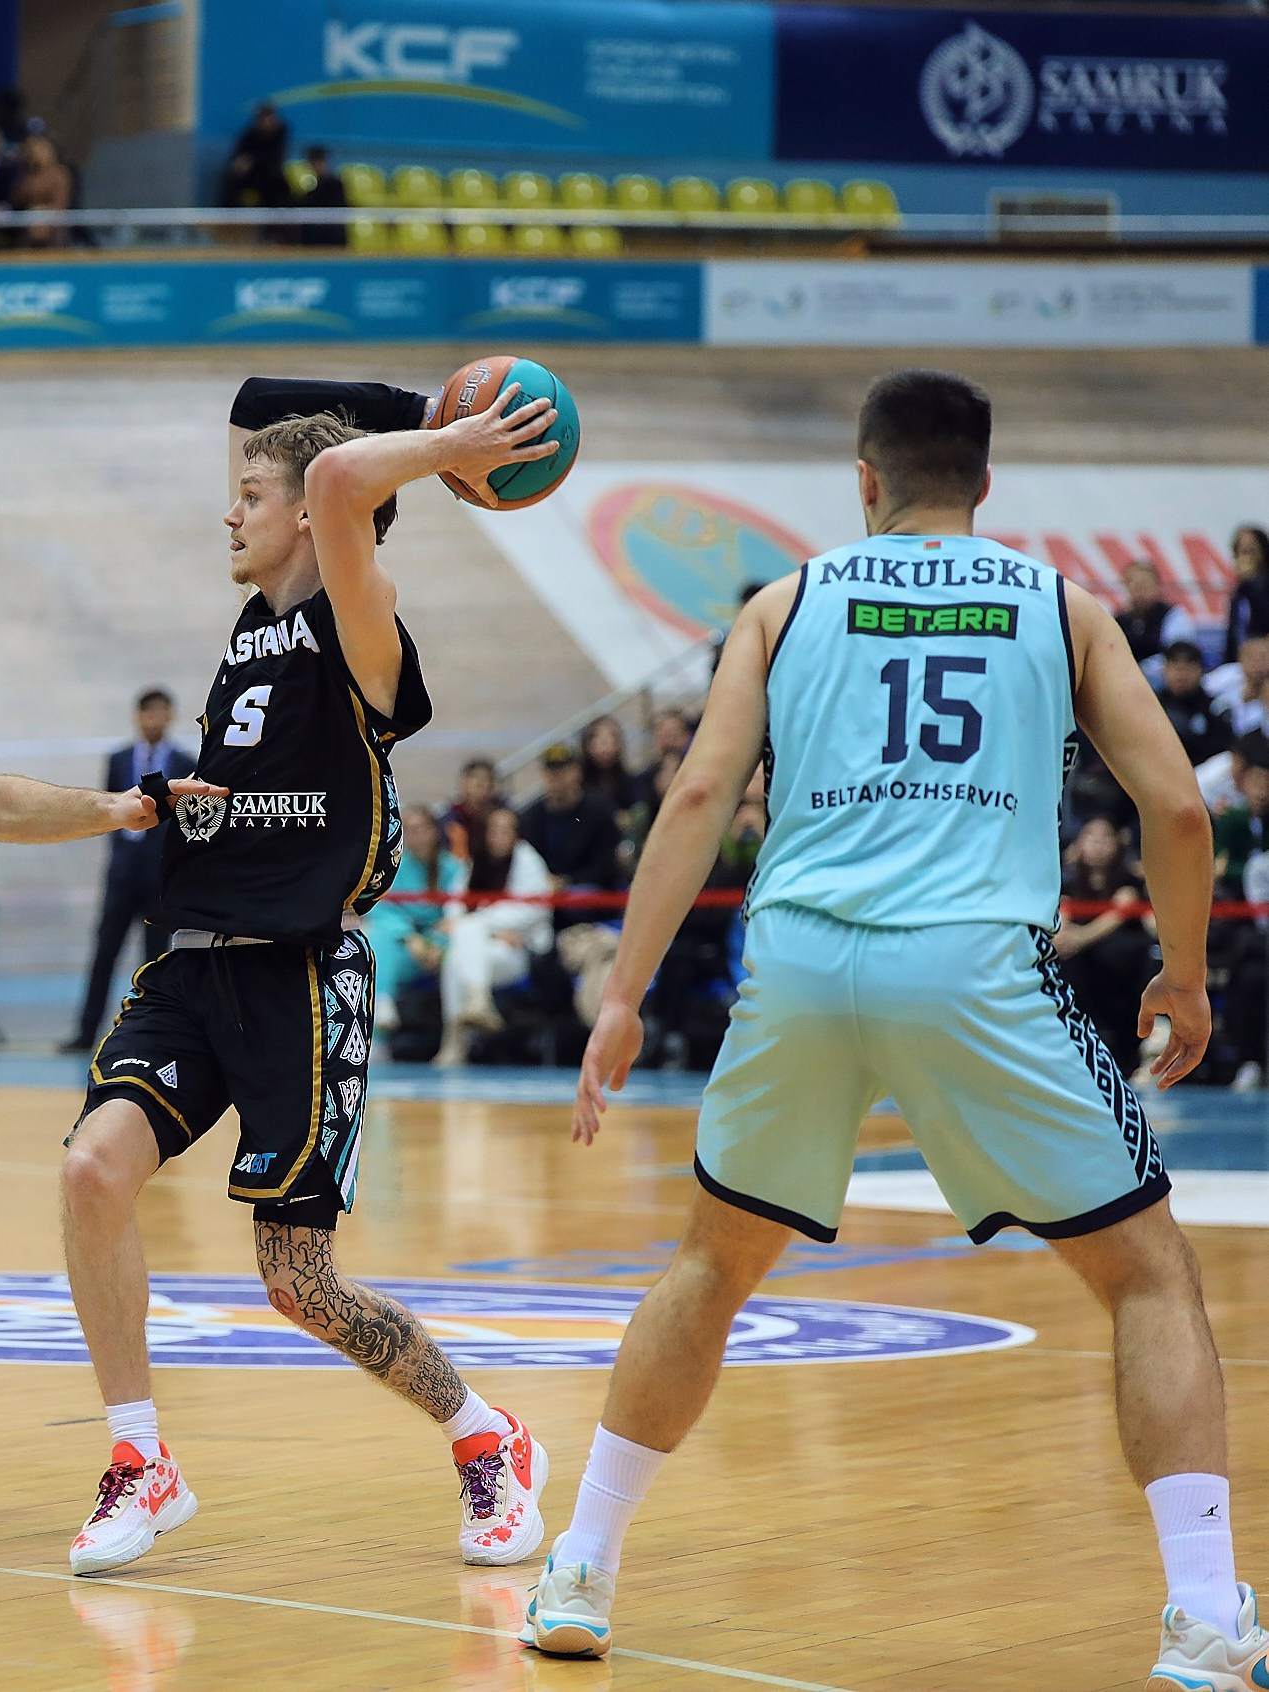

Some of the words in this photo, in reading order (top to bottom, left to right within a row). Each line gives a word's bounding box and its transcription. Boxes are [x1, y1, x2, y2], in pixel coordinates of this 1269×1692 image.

[324, 18, 519, 82] KCF
[819, 555, 1043, 591] MIKULSKI
[854, 603, 1010, 633] BETERA
[881, 655, 987, 764] 15
[231, 794, 327, 815] SAMRUK
[811, 780, 1019, 816] BELTAMOZHSERVIC
[229, 816, 327, 828] KAZYNA
